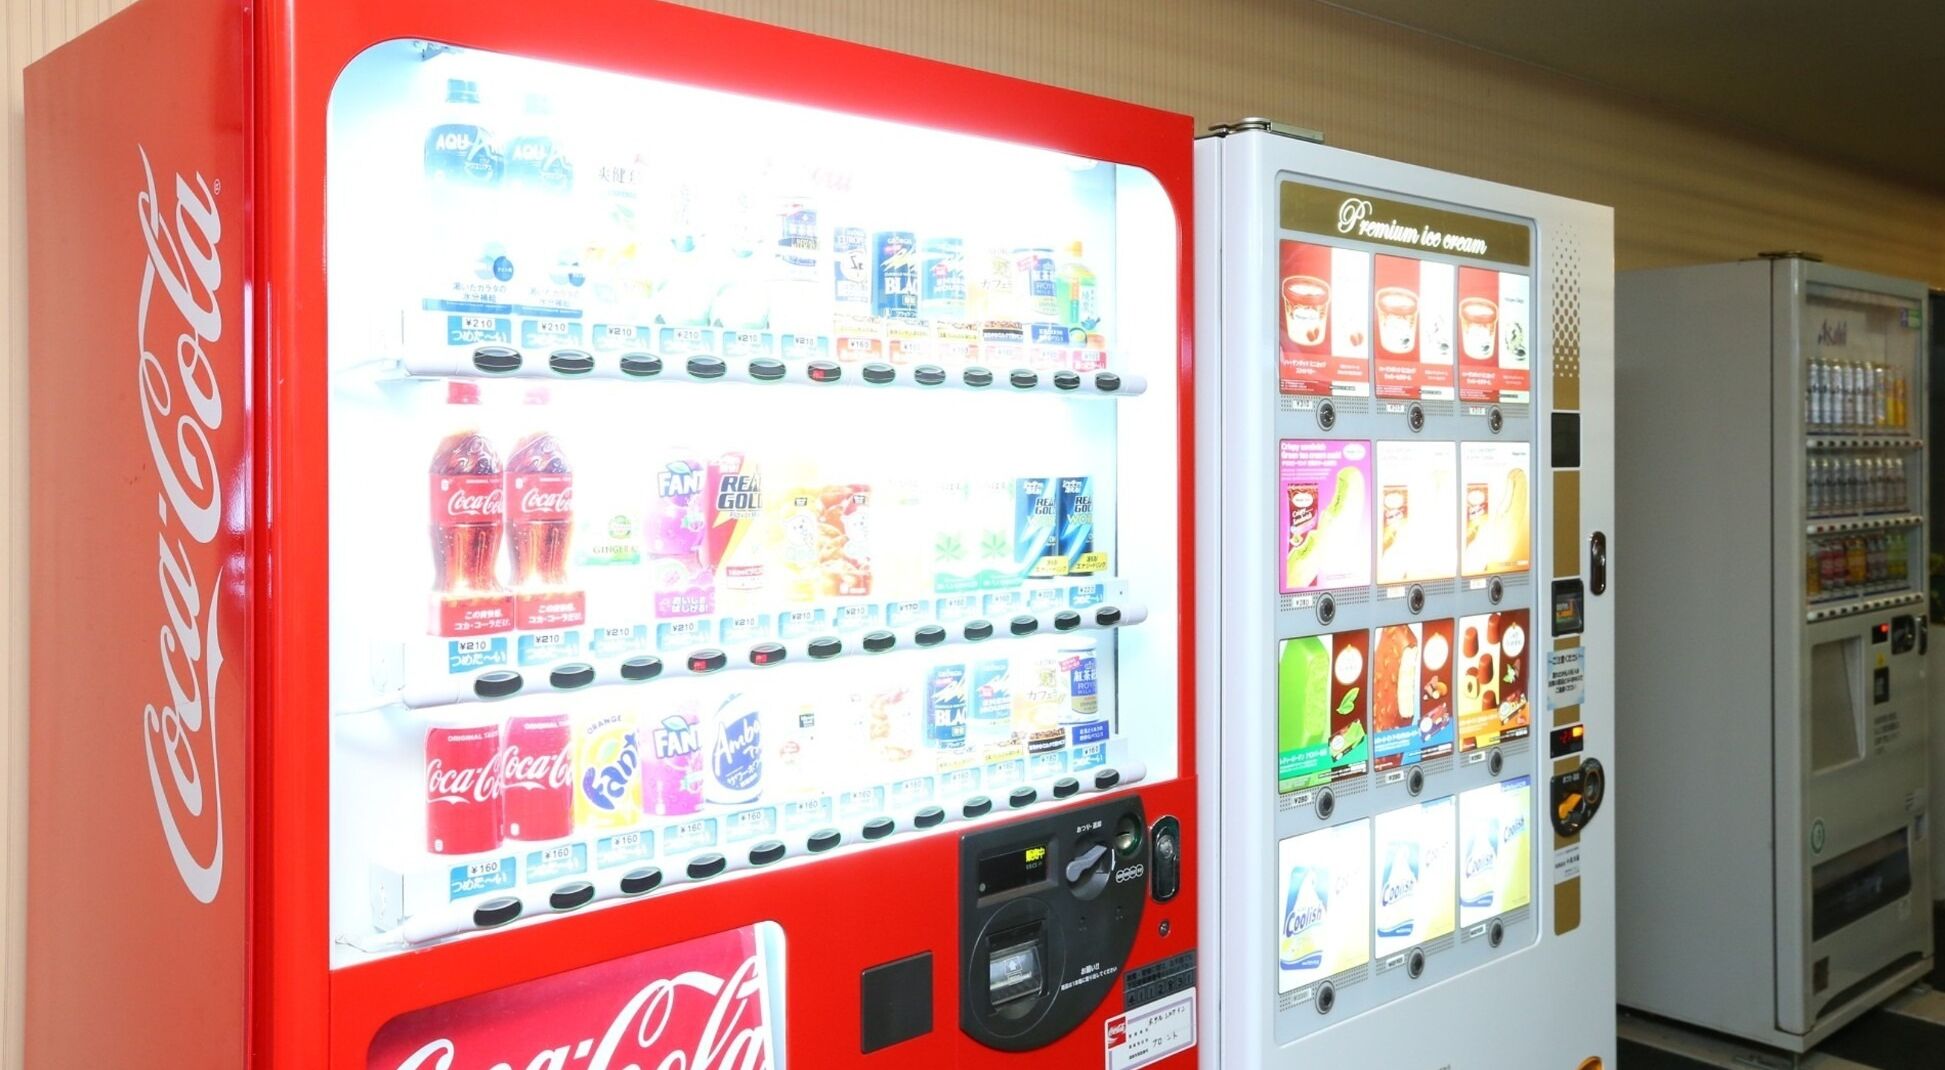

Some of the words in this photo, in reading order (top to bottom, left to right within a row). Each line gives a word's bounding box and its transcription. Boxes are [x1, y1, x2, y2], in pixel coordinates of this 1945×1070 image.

[1337, 197, 1420, 243] Premium
[1420, 225, 1442, 248] ice
[1442, 231, 1488, 255] cream
[465, 319, 493, 329] ¥210
[540, 321, 566, 332] ¥210
[608, 327, 632, 337] ¥210
[720, 474, 762, 493] REA
[138, 143, 224, 904] Coca-Cola
[672, 622, 695, 632] ¥210
[734, 618, 756, 627] ¥210
[606, 627, 630, 637] ¥210
[535, 634, 560, 644] ¥210
[459, 640, 486, 651] ¥210
[740, 811, 762, 822] ¥160
[680, 822, 703, 834] ¥160
[614, 834, 638, 846] ¥160
[544, 847, 569, 859] ¥160
[470, 861, 498, 874] ¥160
[1285, 903, 1323, 938] Coolish
